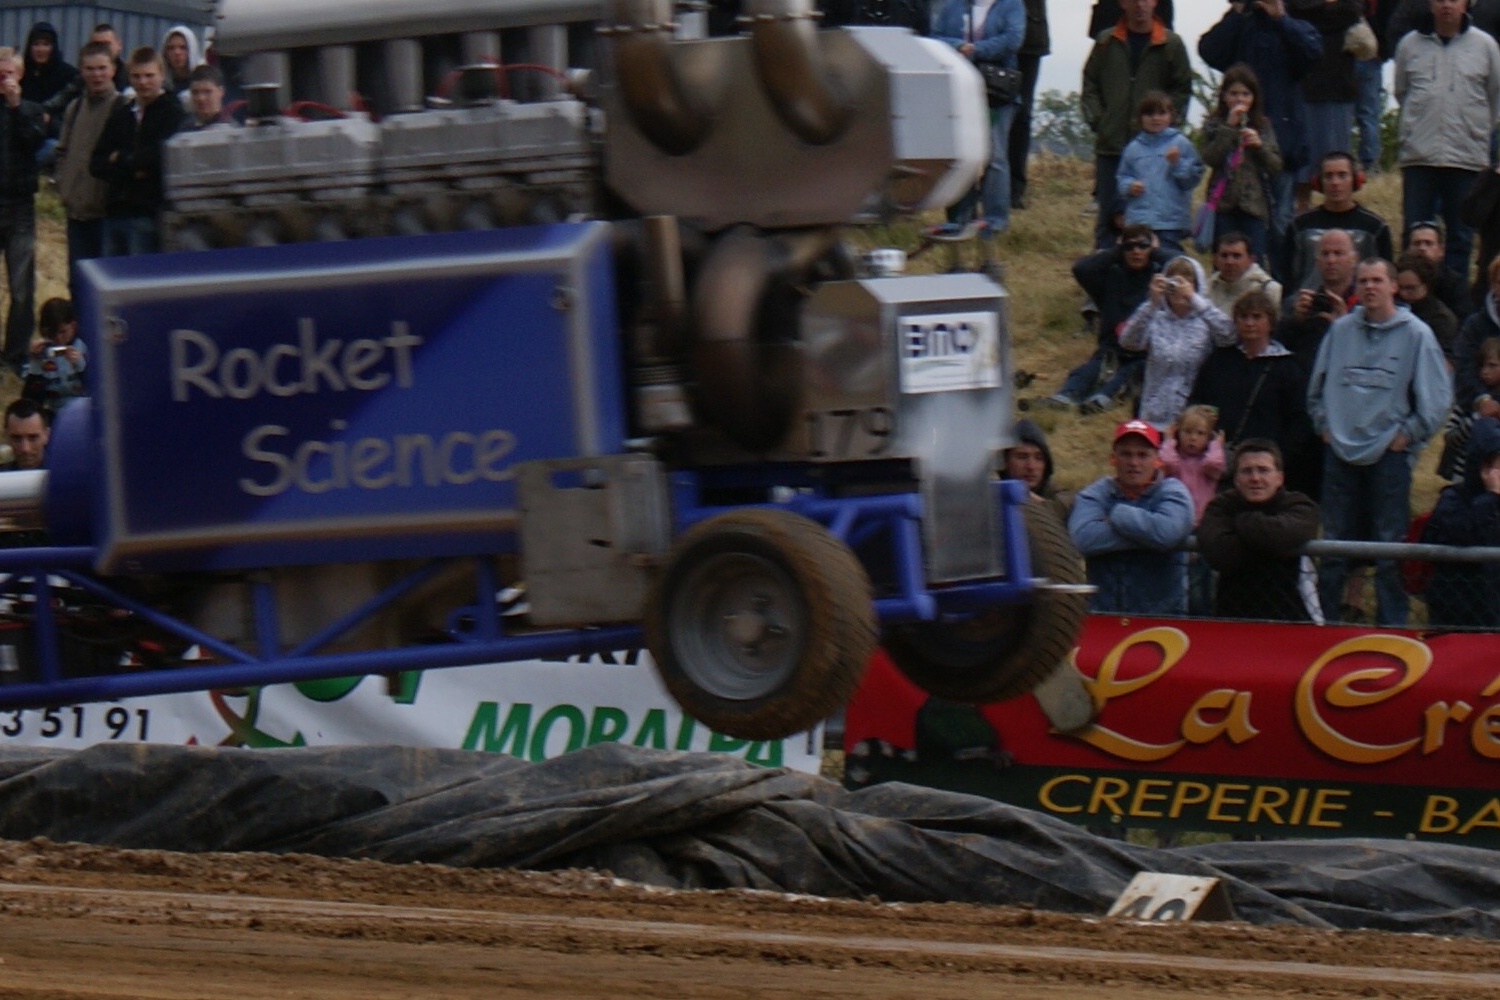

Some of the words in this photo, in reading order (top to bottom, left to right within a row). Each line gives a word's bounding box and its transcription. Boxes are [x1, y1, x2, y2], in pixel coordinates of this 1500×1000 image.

[170, 317, 423, 402] Rocket
[238, 419, 518, 497] Science
[41, 705, 84, 739] 51
[105, 706, 150, 741] 91
[1049, 626, 1260, 762] La
[1038, 774, 1352, 829] CREPERIE
